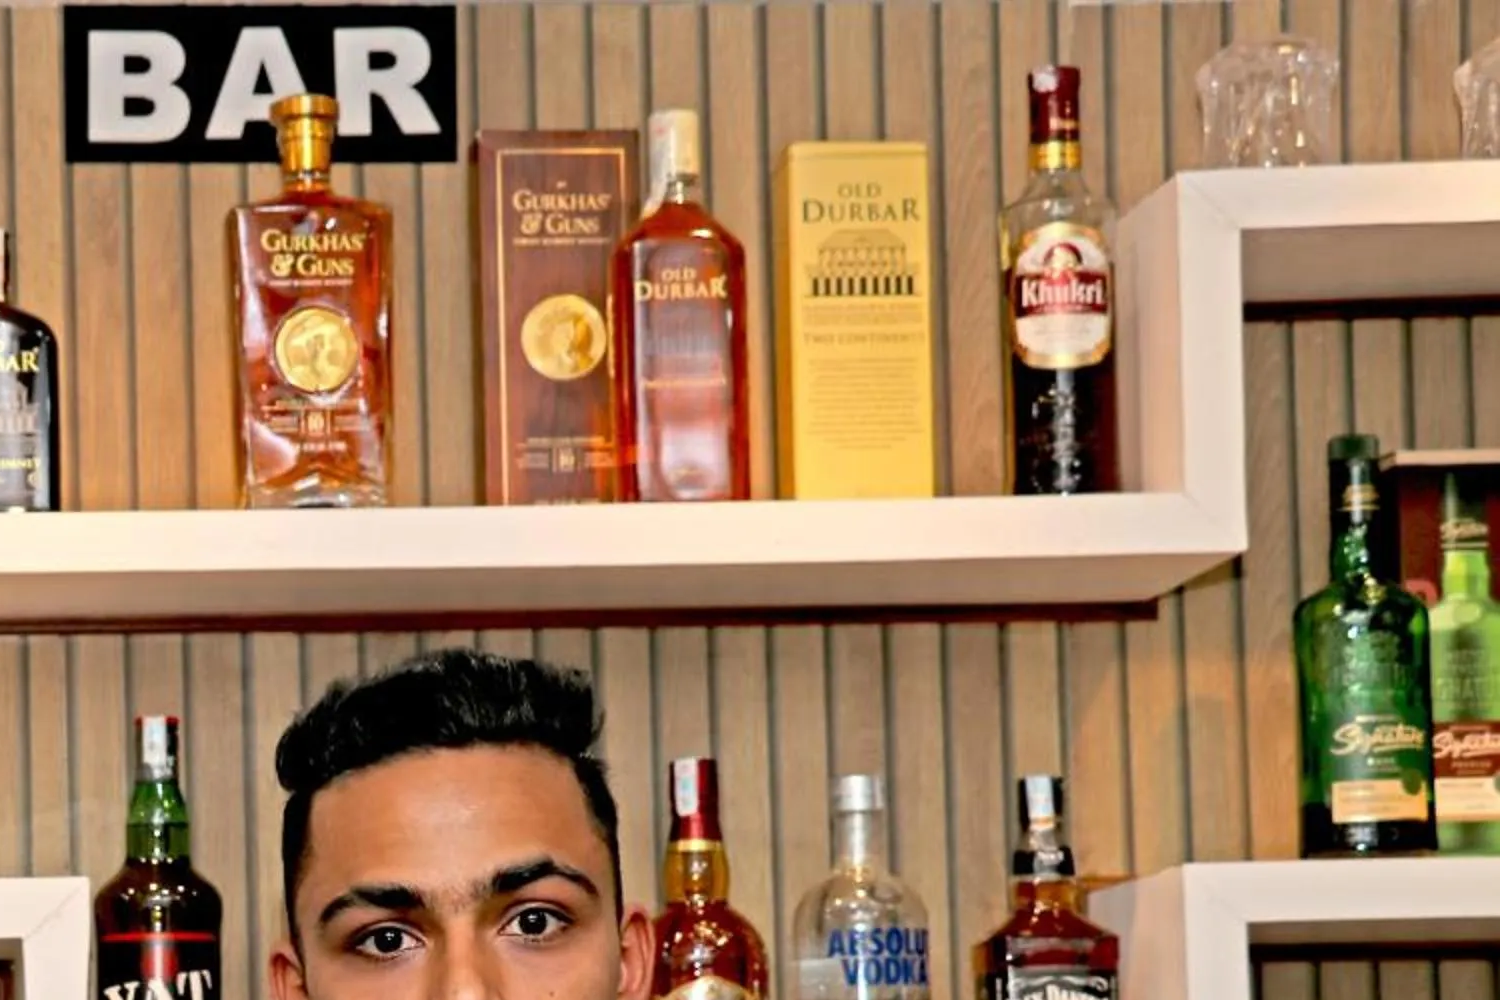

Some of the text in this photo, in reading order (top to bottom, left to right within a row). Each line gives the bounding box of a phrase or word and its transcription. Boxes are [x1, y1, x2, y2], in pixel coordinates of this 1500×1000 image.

[88, 26, 441, 143] BAR
[838, 183, 881, 198] OLD
[802, 198, 920, 223] DURBAR
[260, 229, 365, 252] GURKHAS
[297, 254, 354, 277] GUNS
[661, 267, 697, 281] OLD
[635, 276, 728, 301] DURBAR
[828, 927, 928, 958] ABSOLU
